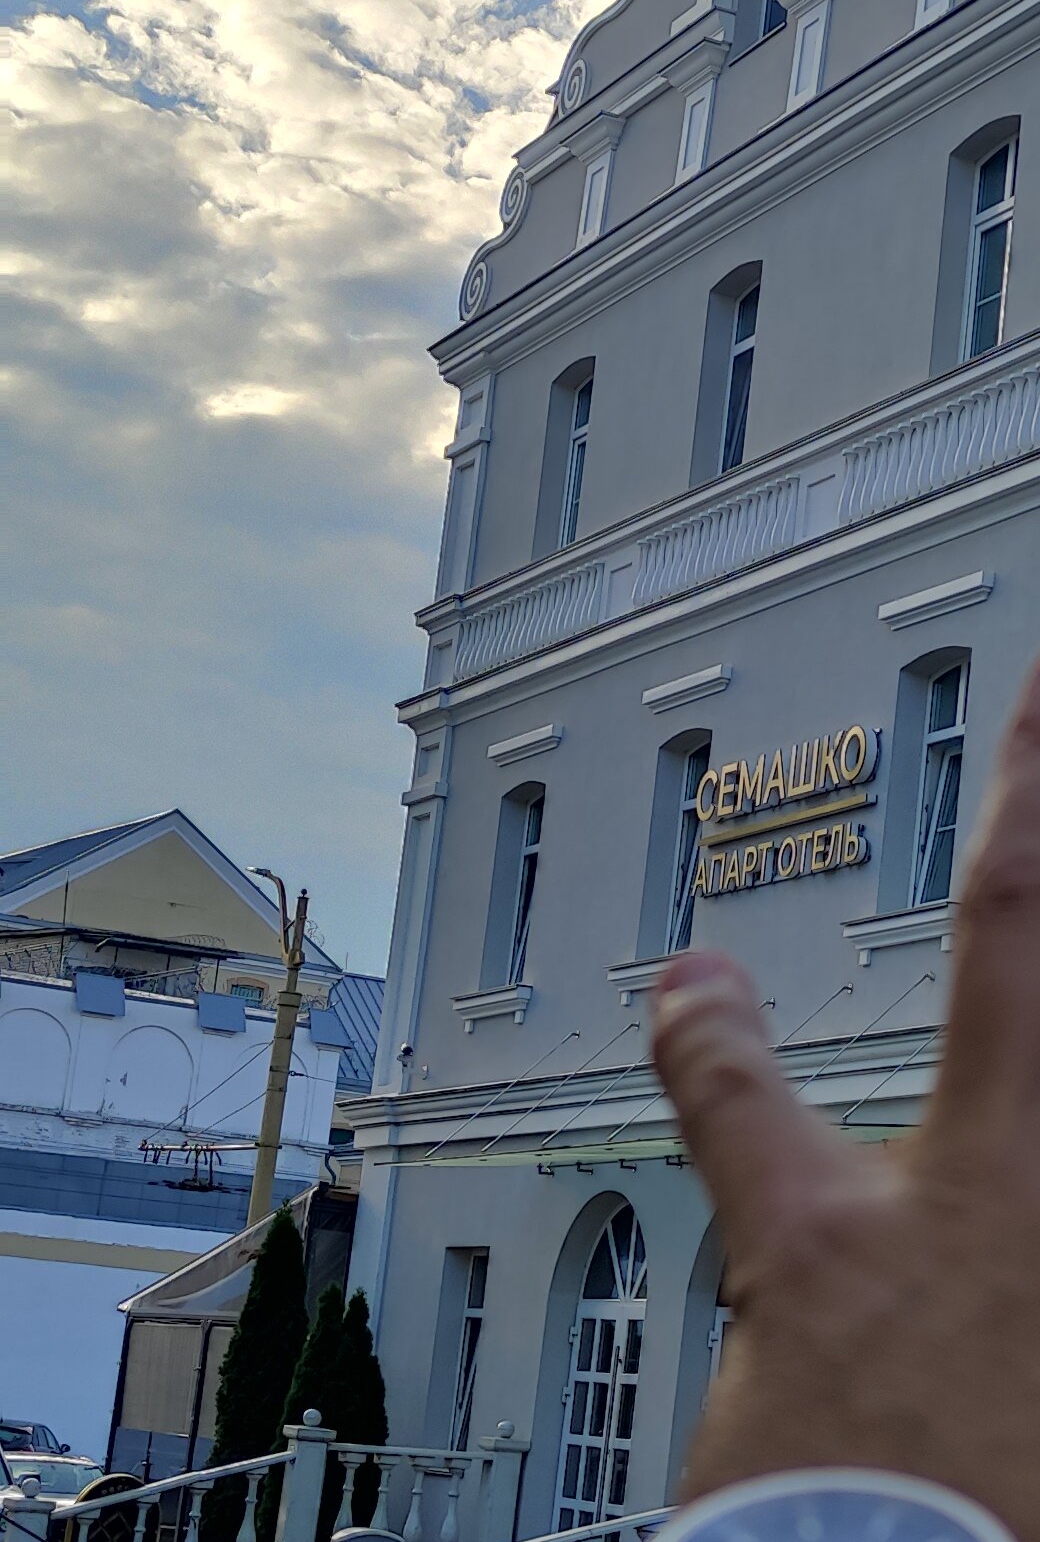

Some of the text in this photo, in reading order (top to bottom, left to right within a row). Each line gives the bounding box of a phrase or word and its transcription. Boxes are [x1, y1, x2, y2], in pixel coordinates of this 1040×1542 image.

[696, 725, 868, 821] СЕМАШКО
[691, 821, 862, 897] АПАРТ ОТЕЛЬ
